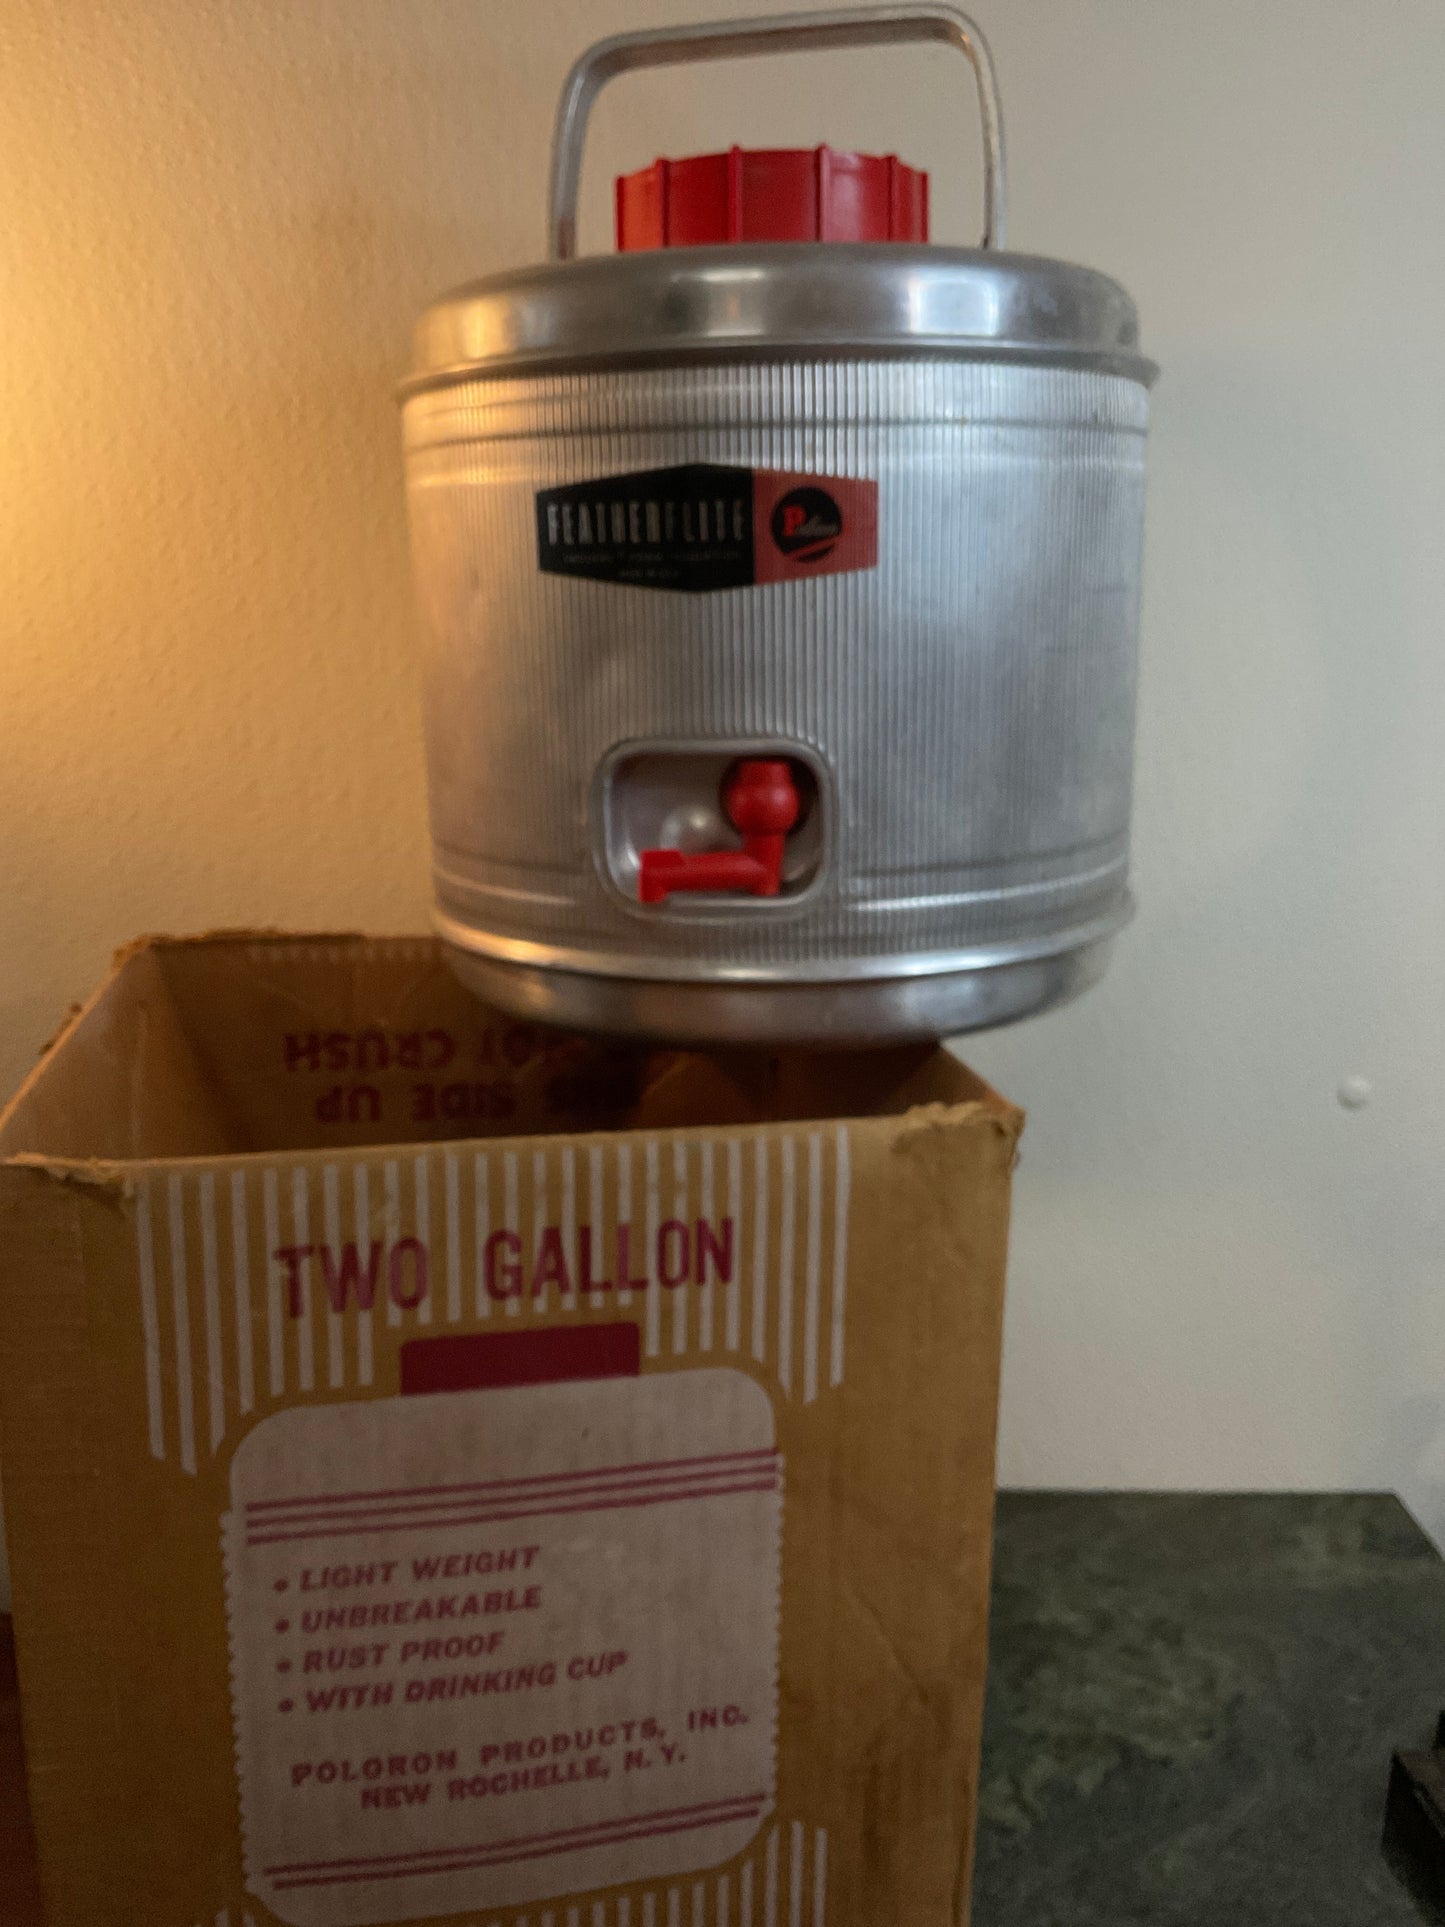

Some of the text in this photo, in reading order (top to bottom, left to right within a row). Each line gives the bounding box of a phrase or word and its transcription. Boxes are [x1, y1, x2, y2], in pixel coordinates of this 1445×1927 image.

[284, 1027, 458, 1073] CRUSH
[314, 1084, 382, 1124] UP
[412, 1082, 517, 1122] SIDE
[273, 1216, 735, 1319] TWO GALLON
[300, 1544, 541, 1593] LIGHT WEIGHT
[301, 1584, 544, 1634] UNBREAKABLE
[302, 1631, 506, 1675] RUST PROOF
[304, 1649, 628, 1714] WITH DRINKING CUP
[290, 1703, 750, 1788] POLORON PRODUCTS, INC.
[359, 1782, 431, 1810] NEW
[447, 1754, 610, 1801] ROCHELLE,
